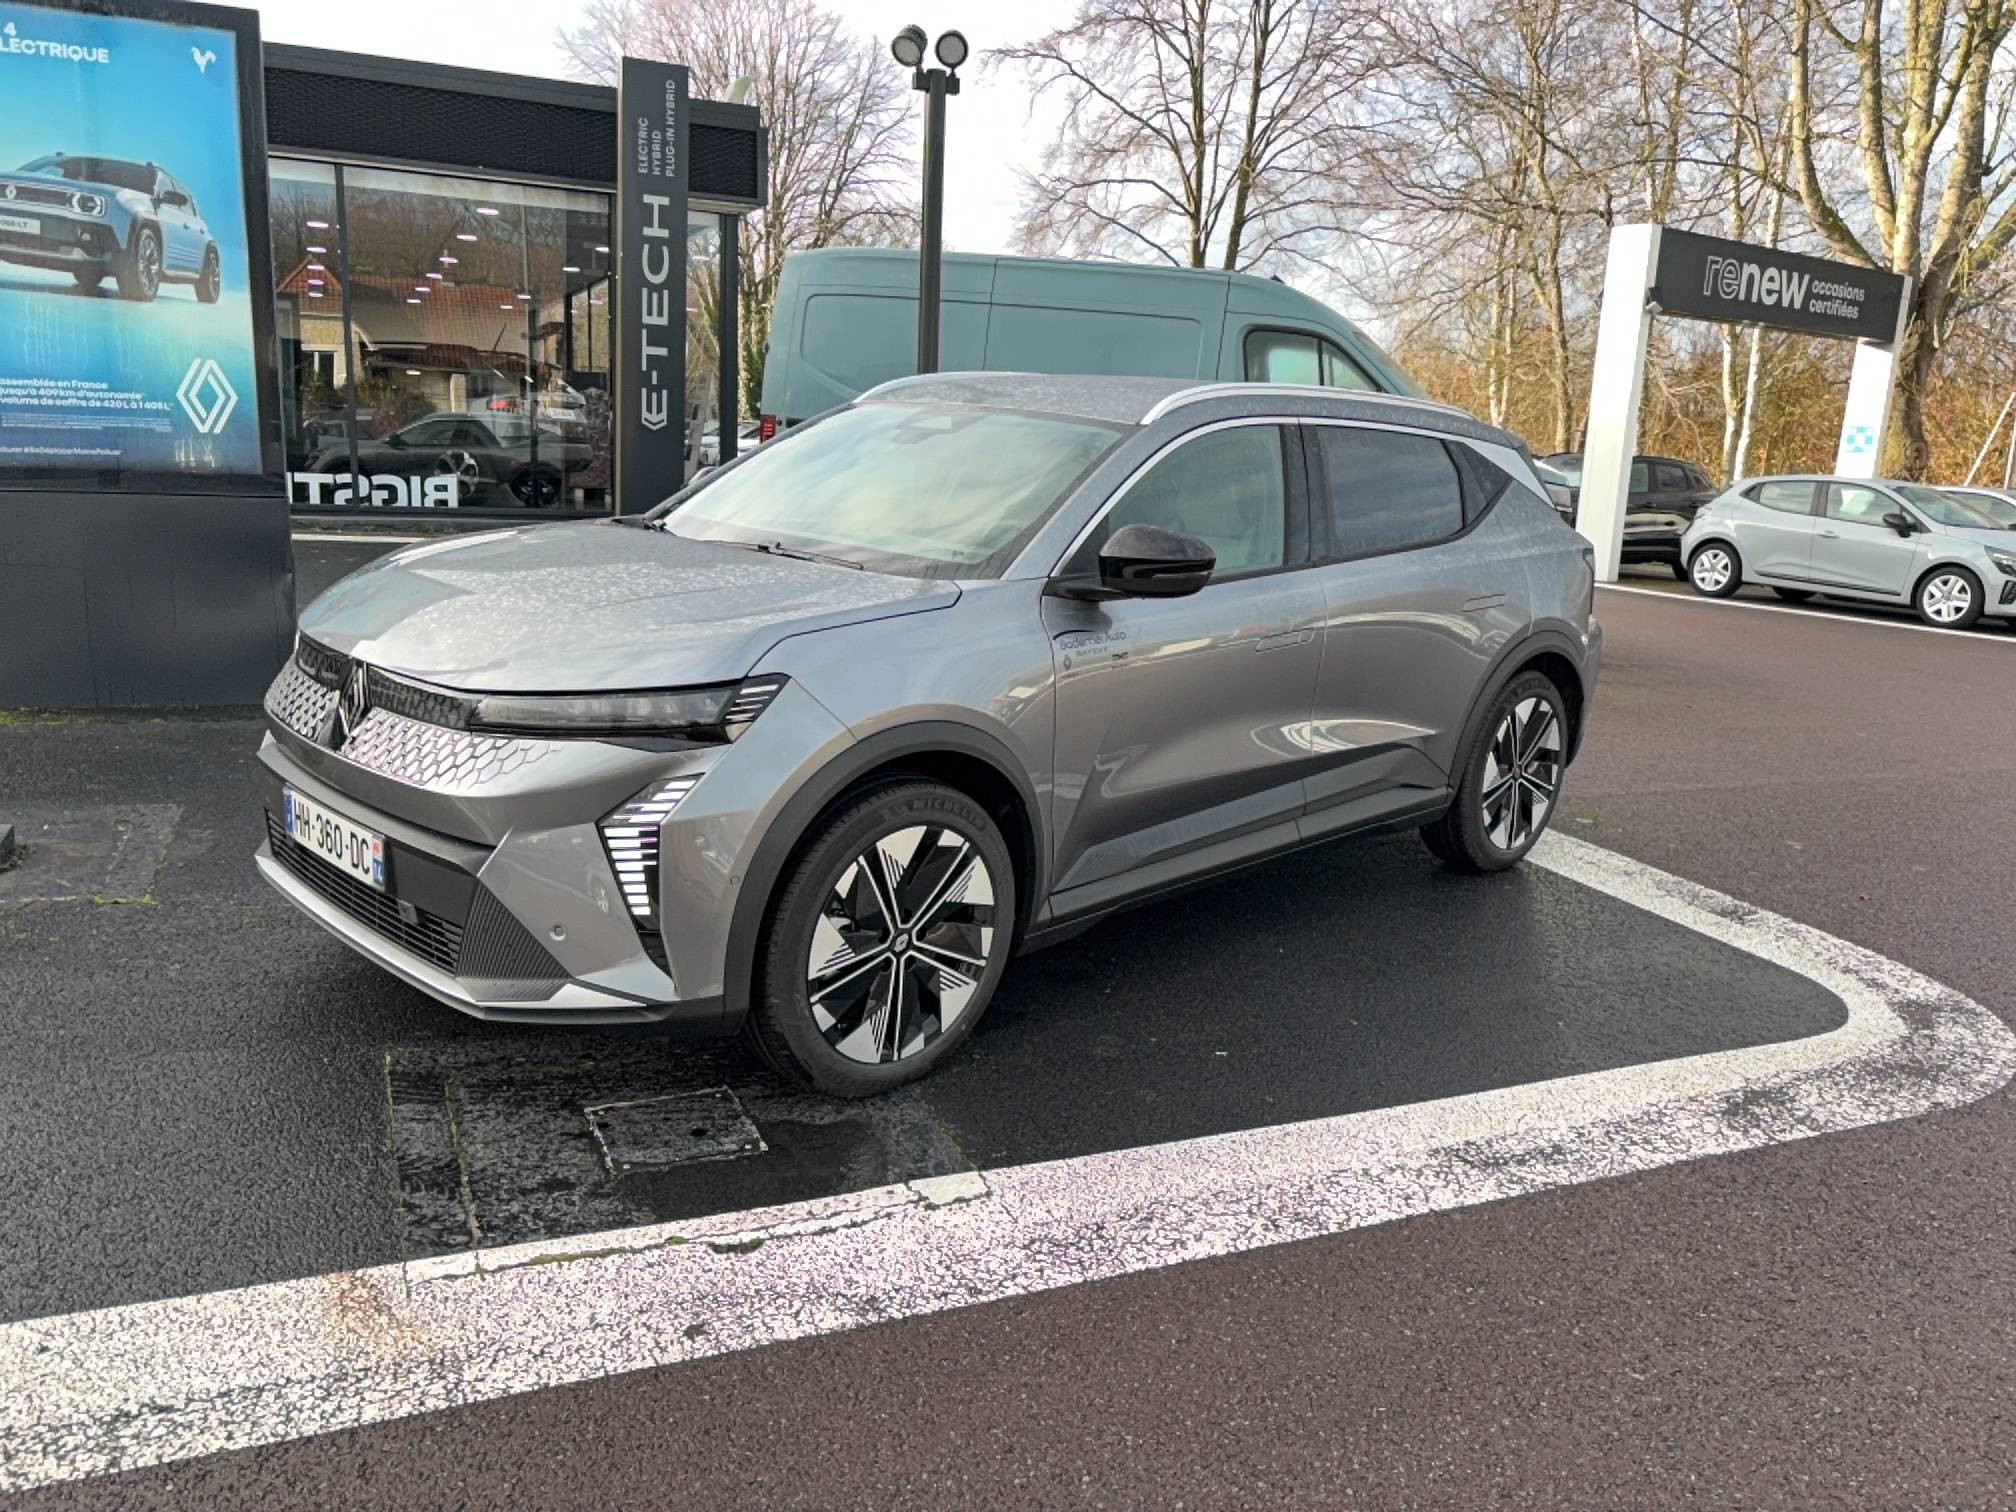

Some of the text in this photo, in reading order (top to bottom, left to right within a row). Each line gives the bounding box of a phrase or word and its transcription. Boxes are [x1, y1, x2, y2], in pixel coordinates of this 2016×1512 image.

[4, 22, 17, 37] 4
[0, 36, 110, 63] LECTRIQUE
[638, 117, 648, 173] ELECTRIC
[666, 80, 675, 176] PLUG-IN HYBRID
[652, 131, 661, 175] HYBRID
[1703, 256, 1810, 310] renew
[1811, 280, 1865, 302] occasions
[641, 194, 670, 430] E-TECH
[1809, 298, 1859, 318] certifiées
[71, 380, 109, 390] France
